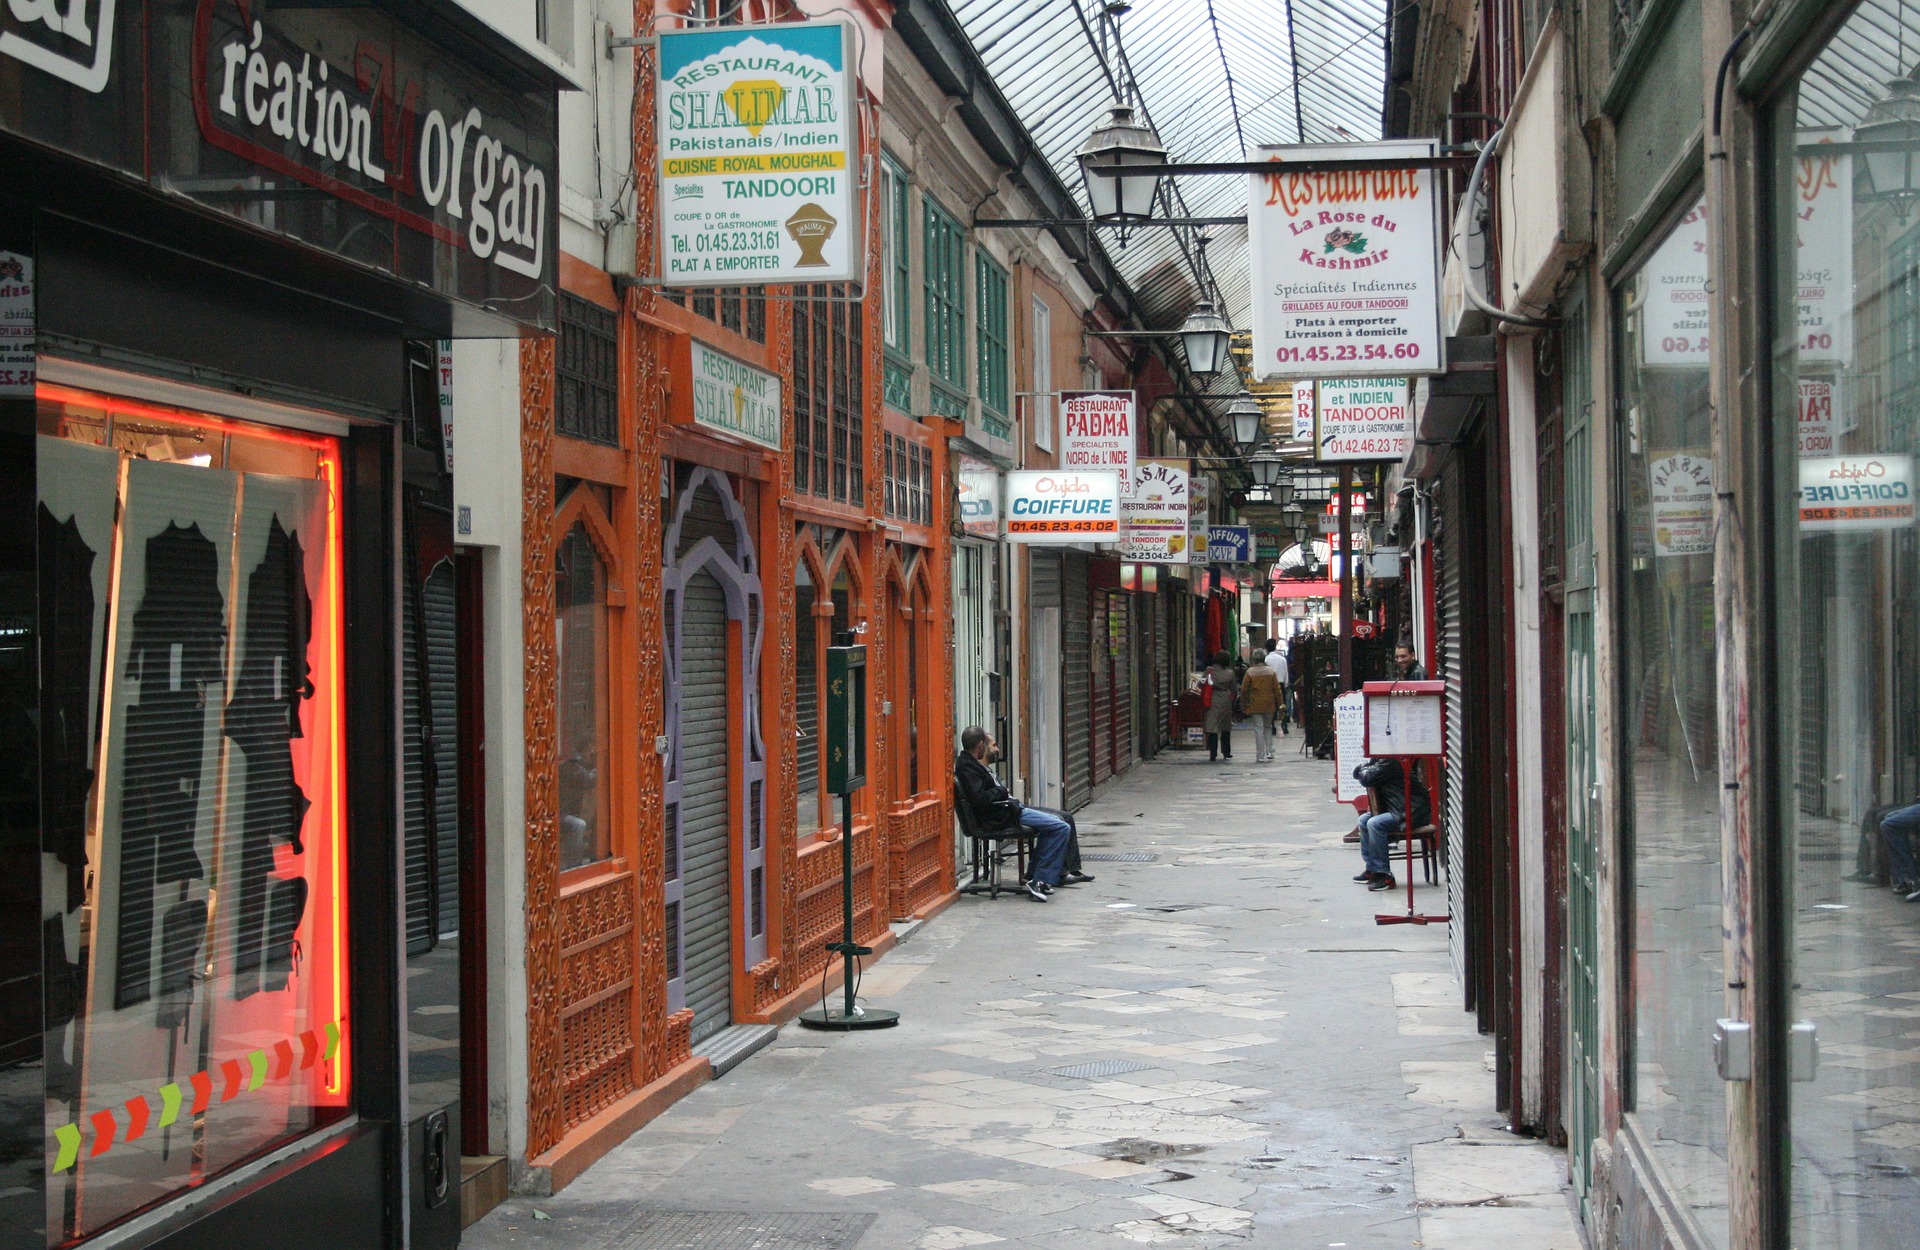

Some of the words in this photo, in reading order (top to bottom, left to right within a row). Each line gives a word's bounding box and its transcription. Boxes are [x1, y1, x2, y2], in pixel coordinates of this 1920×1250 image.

[673, 58, 828, 89] RESTAURANT
[669, 84, 838, 130] SHALIMAR
[669, 159, 717, 174] CUISNE
[723, 157, 764, 171] ROYAL
[770, 154, 837, 169] MOUGHAL
[722, 177, 834, 199] TANDOORI
[1264, 154, 1419, 217] Restaurant
[674, 213, 702, 221] COUPE
[705, 223, 714, 231] La
[717, 220, 778, 230] GASTRONOMIE
[1288, 219, 1314, 237] La
[1317, 210, 1365, 225] Rose
[1371, 214, 1396, 232] du
[671, 235, 690, 253] Tel.
[696, 231, 779, 252] 01.45.23.31.61
[671, 259, 698, 272] PLAT
[703, 258, 711, 271] A
[716, 256, 779, 270] EMPORTER
[1298, 249, 1389, 270] Kashmir
[1274, 280, 1346, 298] Spécialités
[1352, 279, 1417, 293] Indiennes
[1282, 302, 1324, 311] GRILLADES
[1326, 301, 1338, 310] AU
[1340, 300, 1363, 309] FOUR
[1365, 299, 1408, 308] TANDOORI
[1295, 318, 1325, 327] Plats
[1328, 317, 1335, 326] à
[1338, 317, 1396, 328] emporter
[1285, 330, 1342, 339] Livraison
[1346, 328, 1352, 337] à
[1355, 327, 1408, 337] domicile
[1276, 343, 1420, 363] 01.45.23.54.60
[702, 350, 767, 398] RESTAURANT
[1321, 377, 1406, 389] PAKISTANAIS
[1067, 400, 1127, 412] RESTAURANT
[1331, 395, 1344, 405] et
[1349, 391, 1393, 404] INDIEN
[694, 376, 777, 444] SHALIMAR
[1322, 406, 1405, 422] TANDOORI
[1066, 413, 1129, 437] PADMA
[1322, 425, 1340, 434] COUPE
[1358, 424, 1364, 433] LA
[1367, 423, 1404, 432] GASTRONOMIE
[1066, 451, 1089, 464] NORD
[1091, 451, 1099, 464] de
[1035, 477, 1090, 498] Oujda
[1136, 467, 1184, 496] ASMIN
[1011, 522, 1114, 532] 01.45.23.43.02
[1208, 530, 1245, 547] OIFFURE
